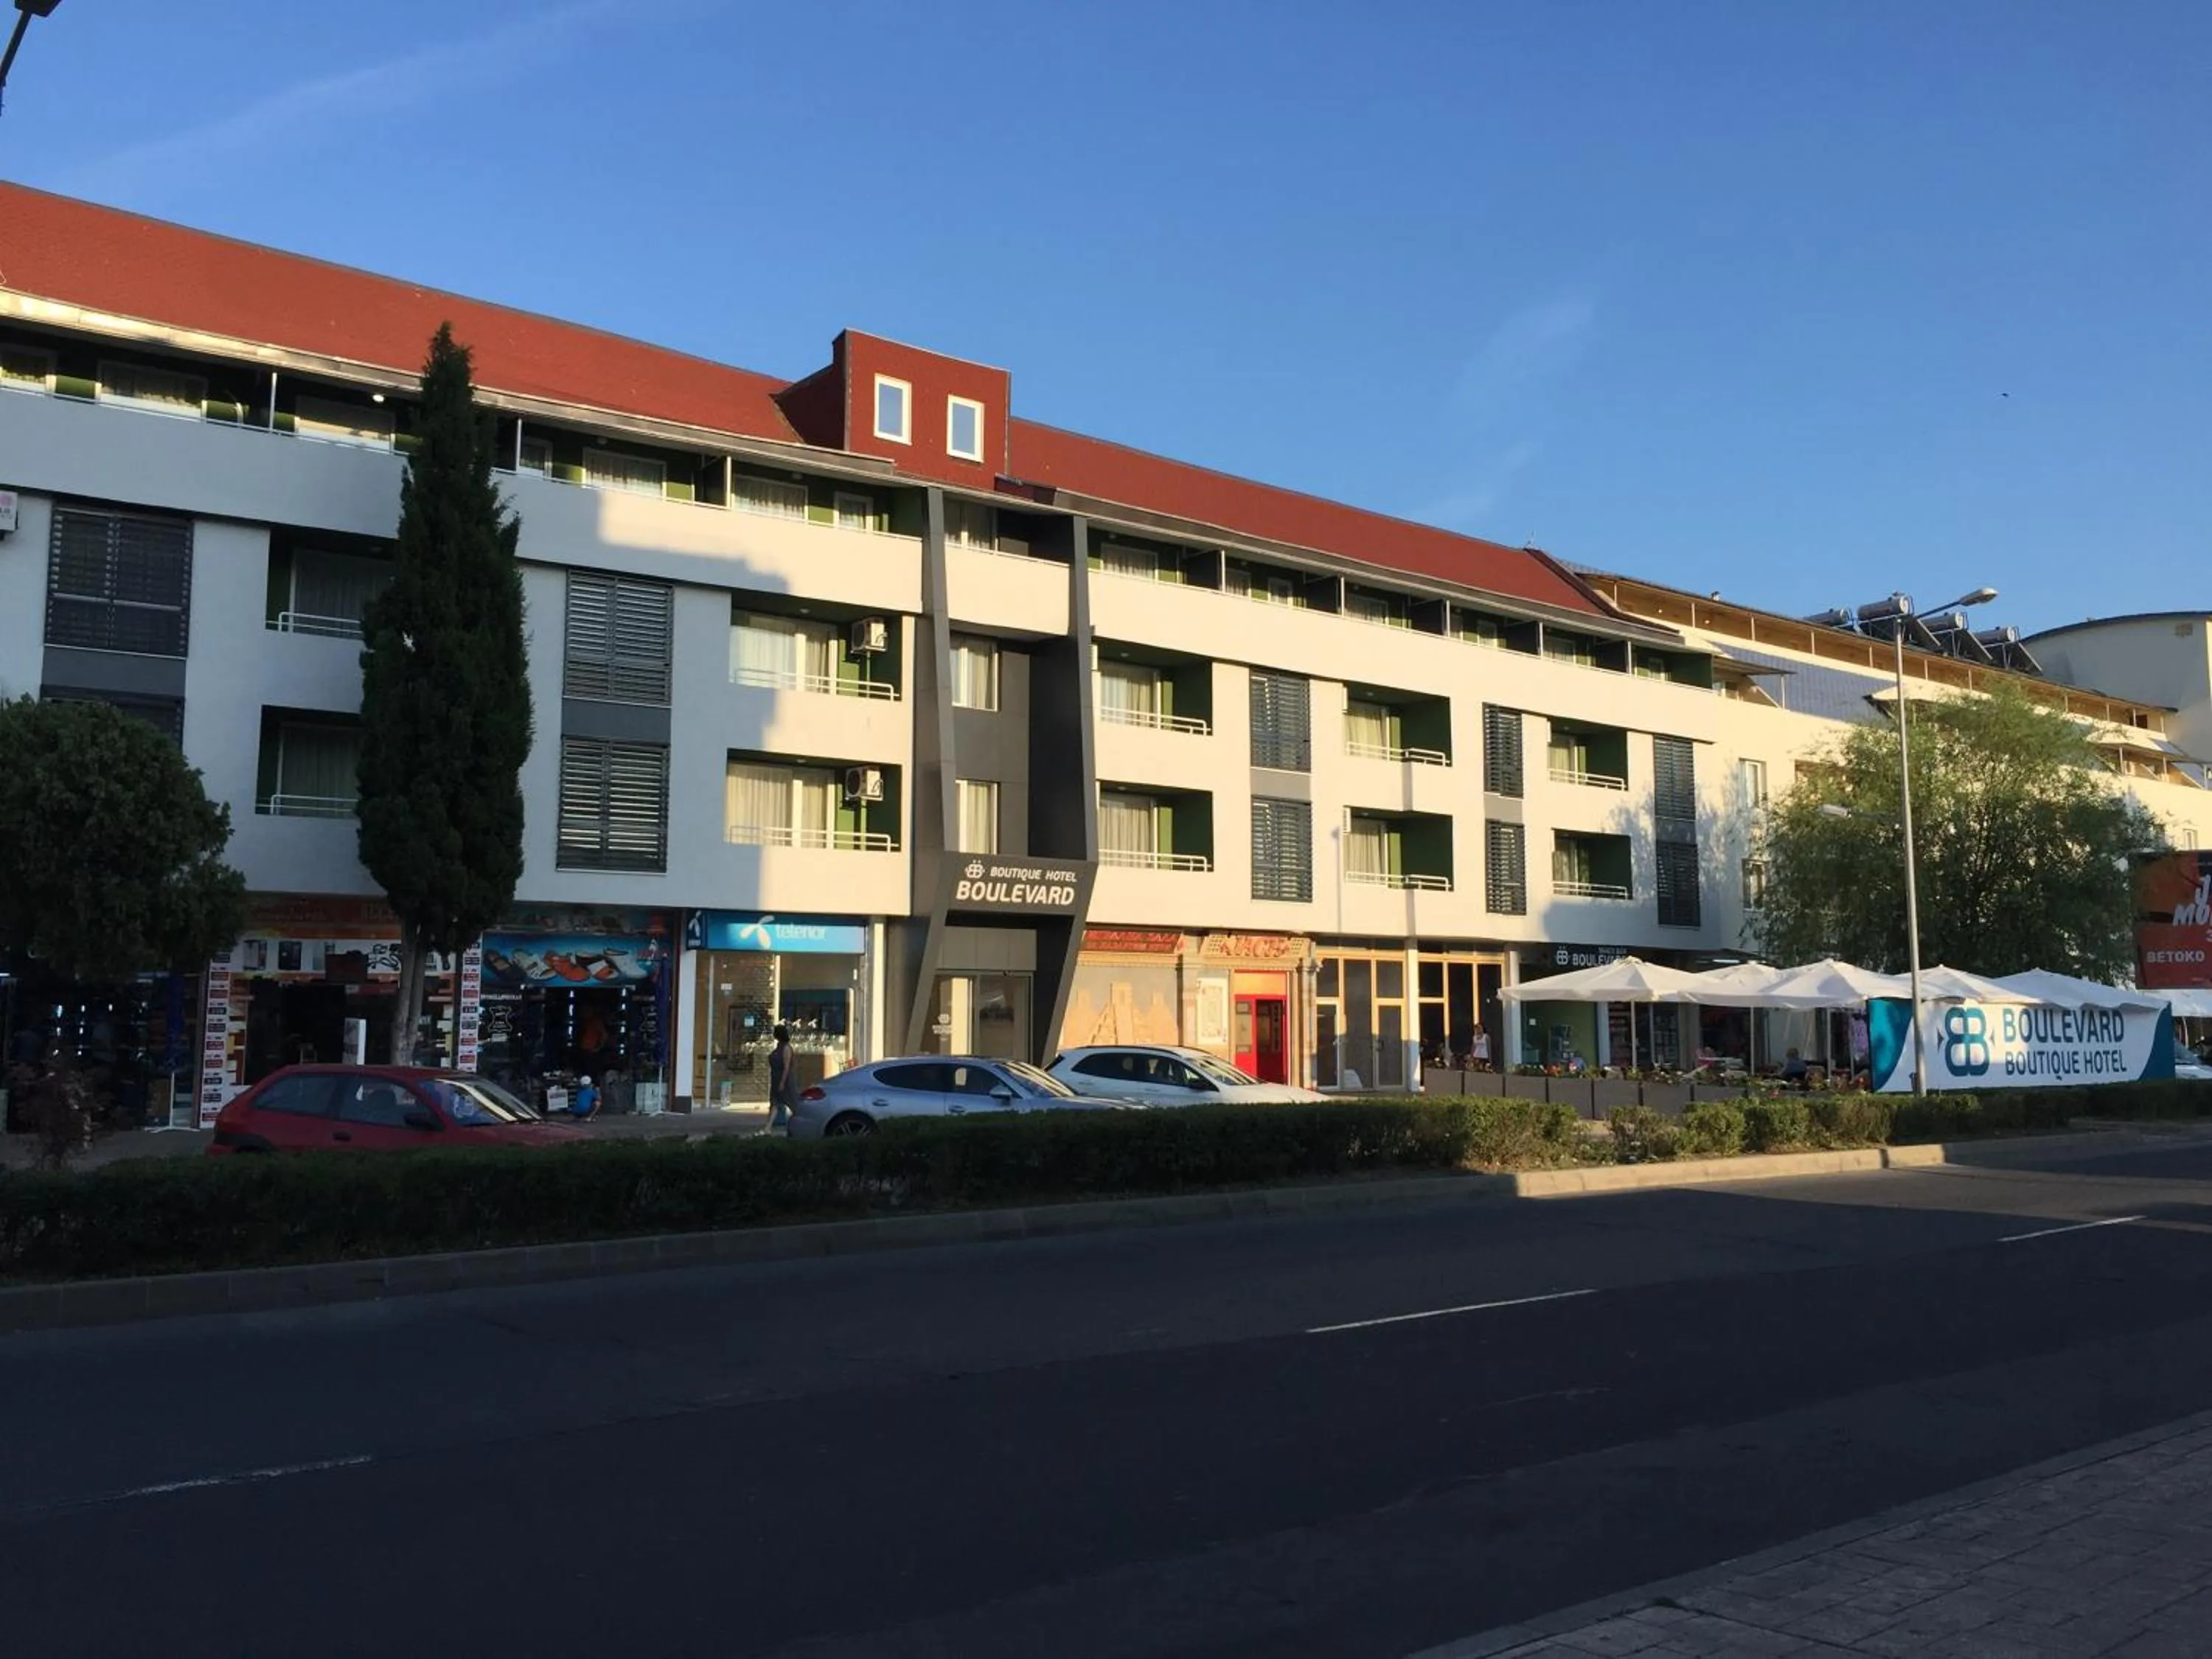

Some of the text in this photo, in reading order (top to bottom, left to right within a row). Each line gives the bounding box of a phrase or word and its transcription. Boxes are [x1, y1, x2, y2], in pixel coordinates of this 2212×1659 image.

[990, 866, 1077, 883] BOUTIQUE HOTEL
[956, 880, 1074, 905] BOULEVARD
[775, 923, 826, 940] telenor
[2002, 1007, 2125, 1043] BOULEVARD
[2005, 1050, 2127, 1081] BOUTIQUE HOTEL
